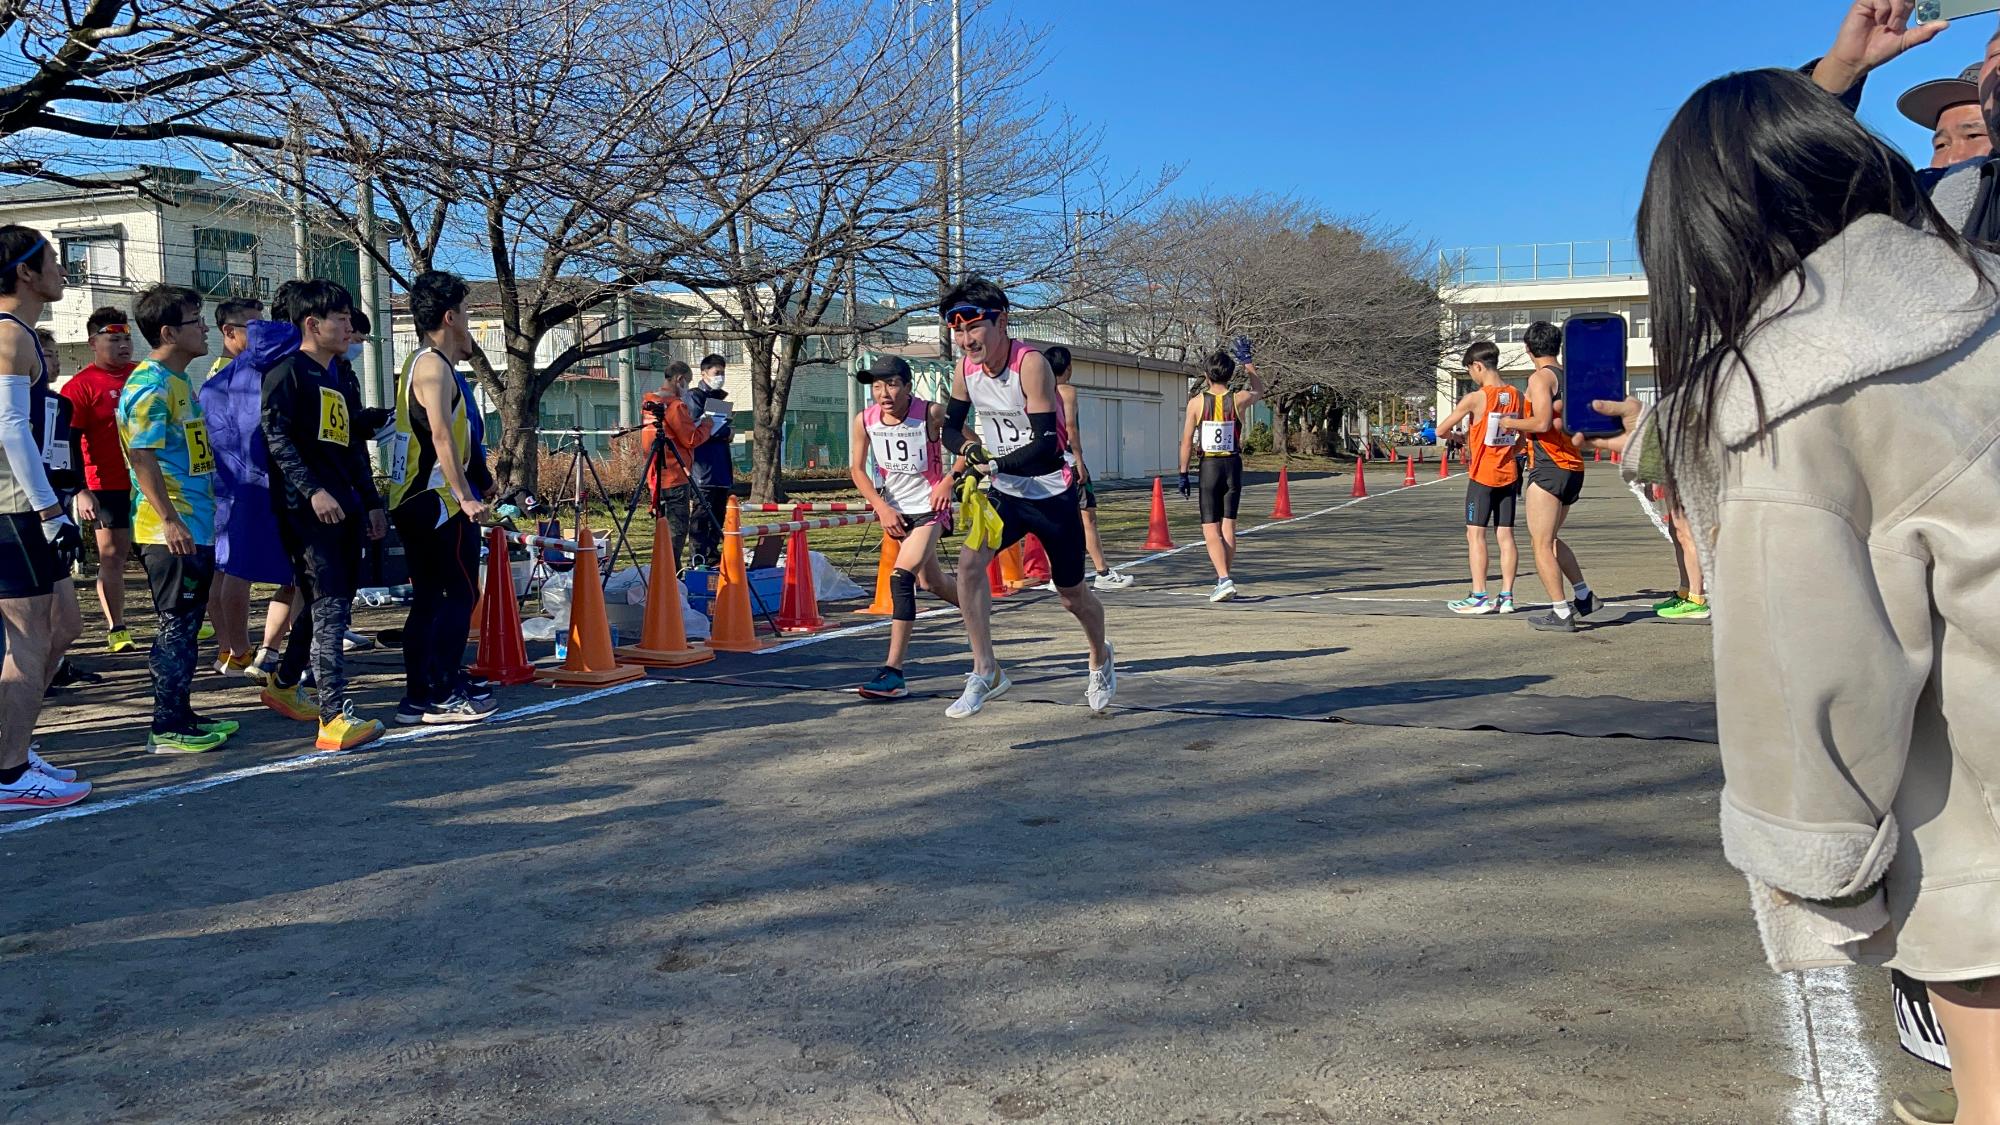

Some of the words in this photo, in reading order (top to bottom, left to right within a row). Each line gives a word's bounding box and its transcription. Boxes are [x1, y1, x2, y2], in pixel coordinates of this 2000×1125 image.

[1214, 428, 1232, 444] 8-2
[885, 439, 923, 461] 19-1
[885, 462, 918, 472] 田代区A
